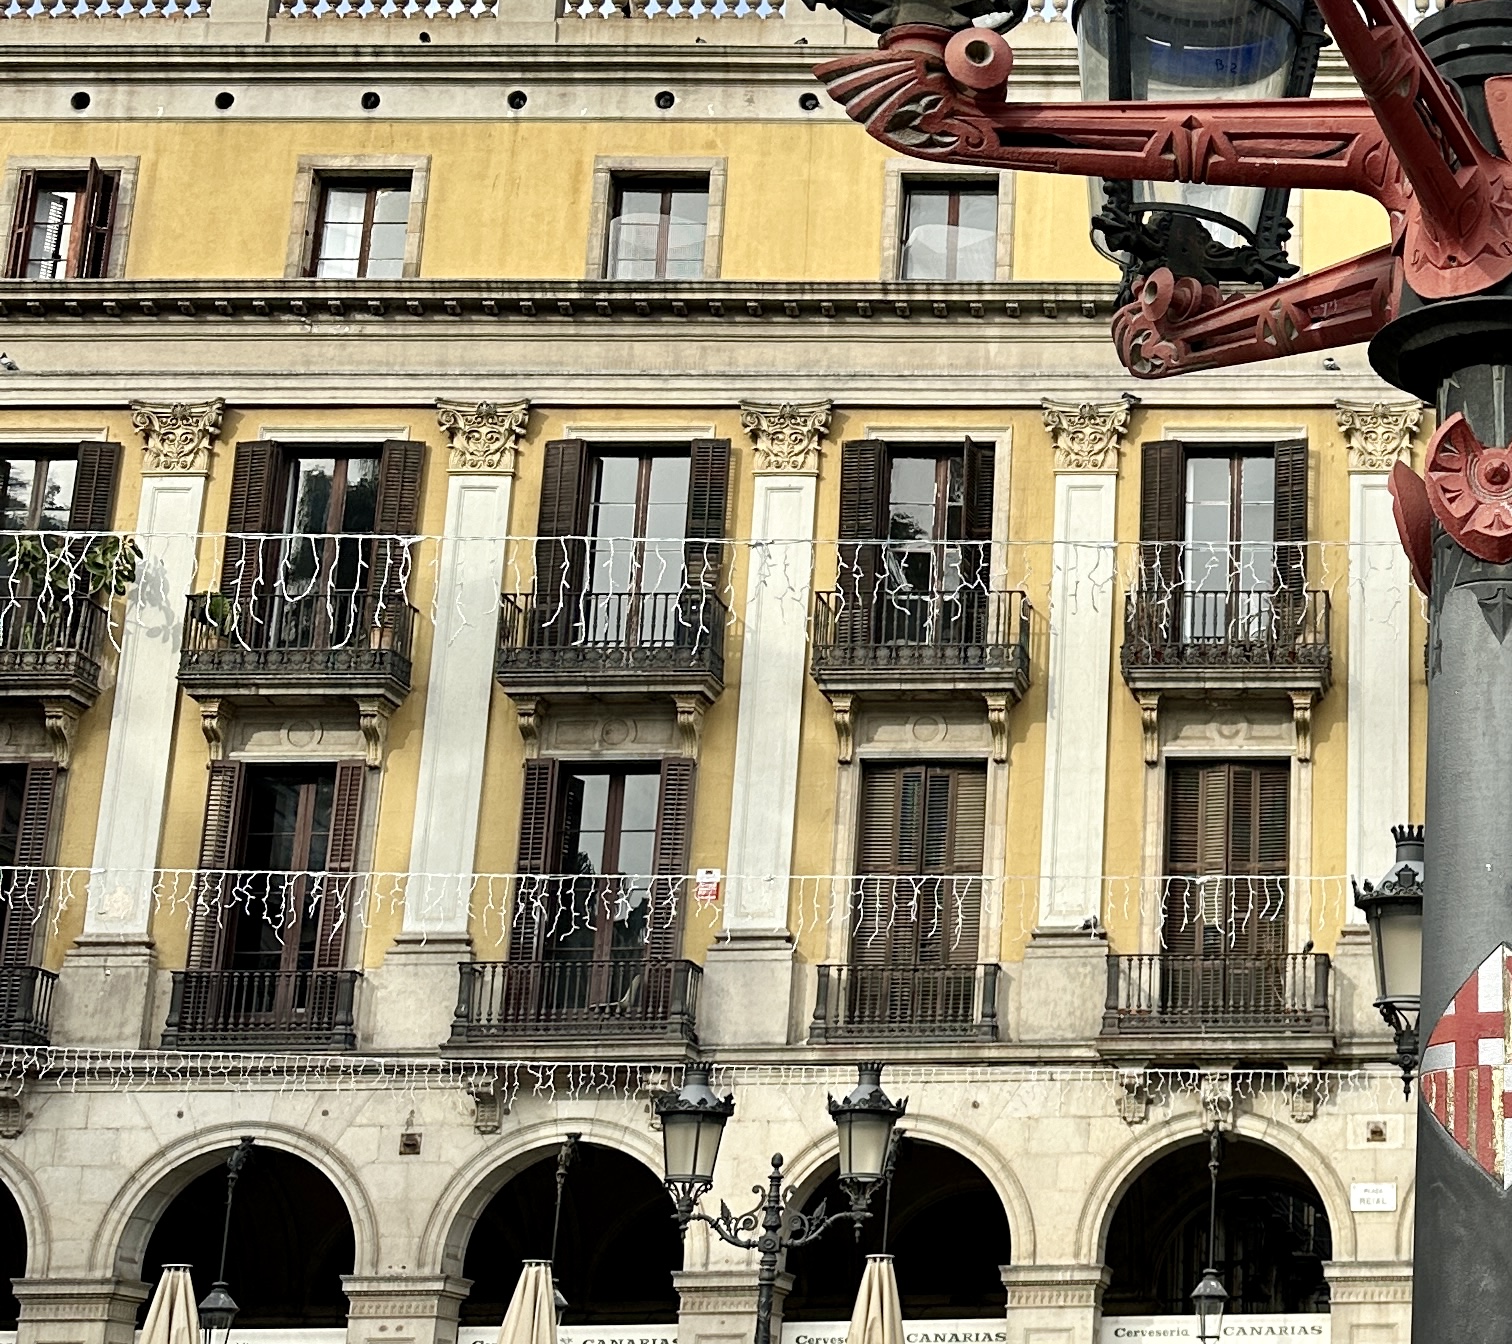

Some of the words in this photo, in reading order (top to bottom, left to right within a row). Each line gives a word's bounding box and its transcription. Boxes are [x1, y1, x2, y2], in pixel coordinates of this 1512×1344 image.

[906, 1332, 1007, 1343] CANARIAS
[1114, 1327, 1190, 1338] Cerveseria
[1223, 1325, 1323, 1336] CANARIAS
